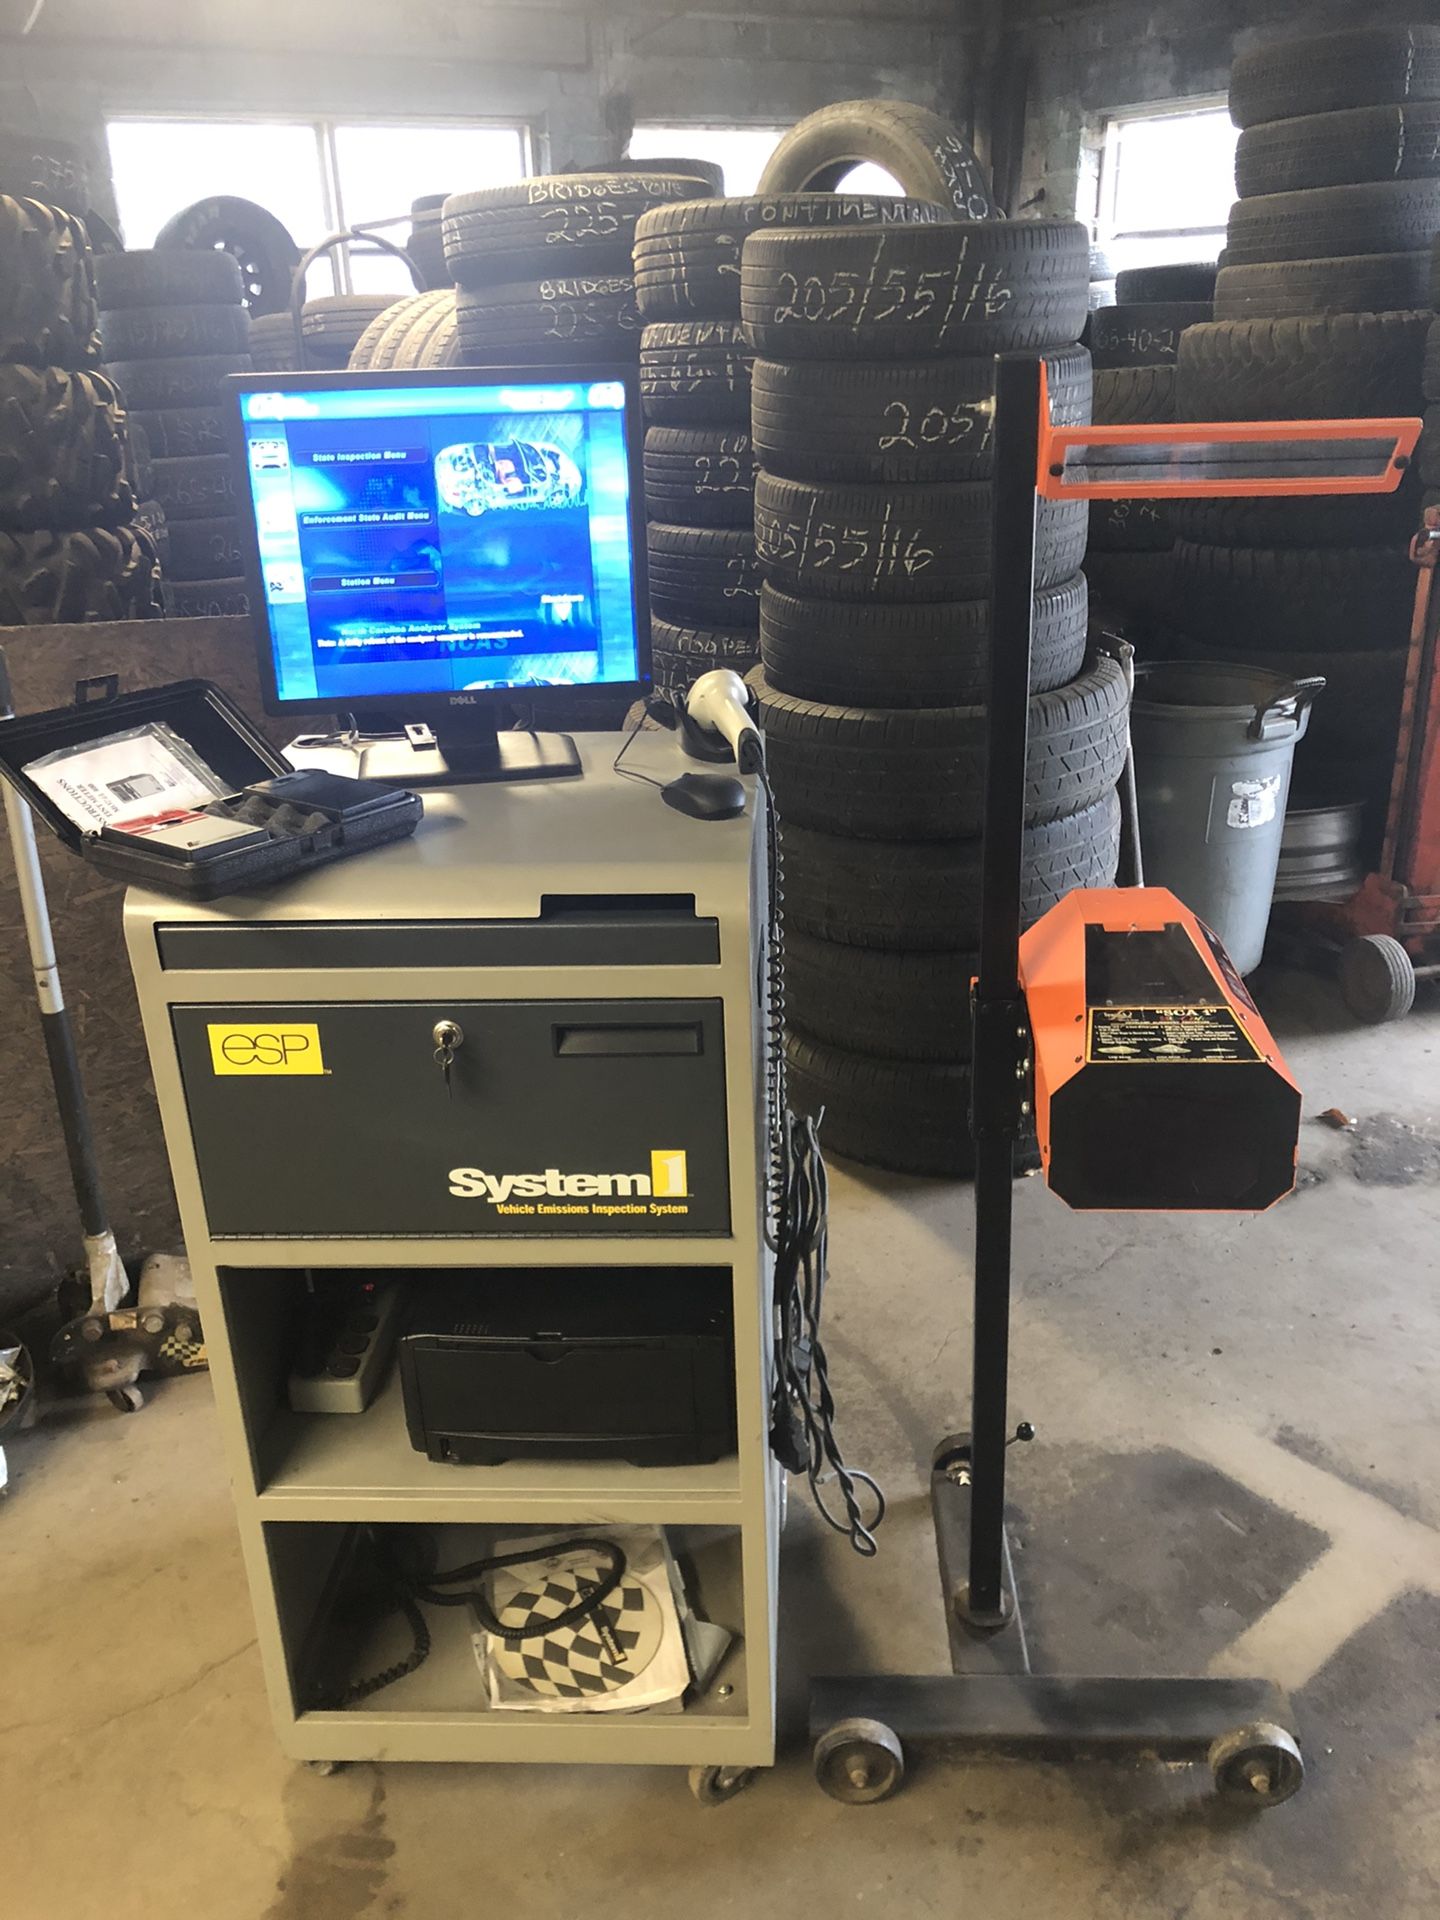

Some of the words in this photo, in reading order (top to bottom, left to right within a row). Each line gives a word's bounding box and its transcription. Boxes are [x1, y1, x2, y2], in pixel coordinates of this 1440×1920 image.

[528, 180, 685, 204] BRIDGESTONE
[774, 234, 1012, 347] 205/55/16
[312, 453, 335, 463] State
[337, 452, 382, 463] Inspection
[384, 450, 407, 460] Menu
[303, 514, 357, 525] Enforcement
[358, 513, 381, 523] State
[382, 512, 405, 522] Audit
[407, 511, 430, 521] Menu
[341, 577, 371, 587] Station
[373, 576, 396, 586] Menu
[408, 623, 447, 633] Analyzer
[450, 696, 476, 706] DELL
[57, 778, 107, 828] NSTRUCTIONS
[496, 1203, 535, 1215] Vehicle
[537, 1203, 590, 1215] Emissions
[592, 1203, 647, 1217] Inspection
[649, 1203, 689, 1217] System
